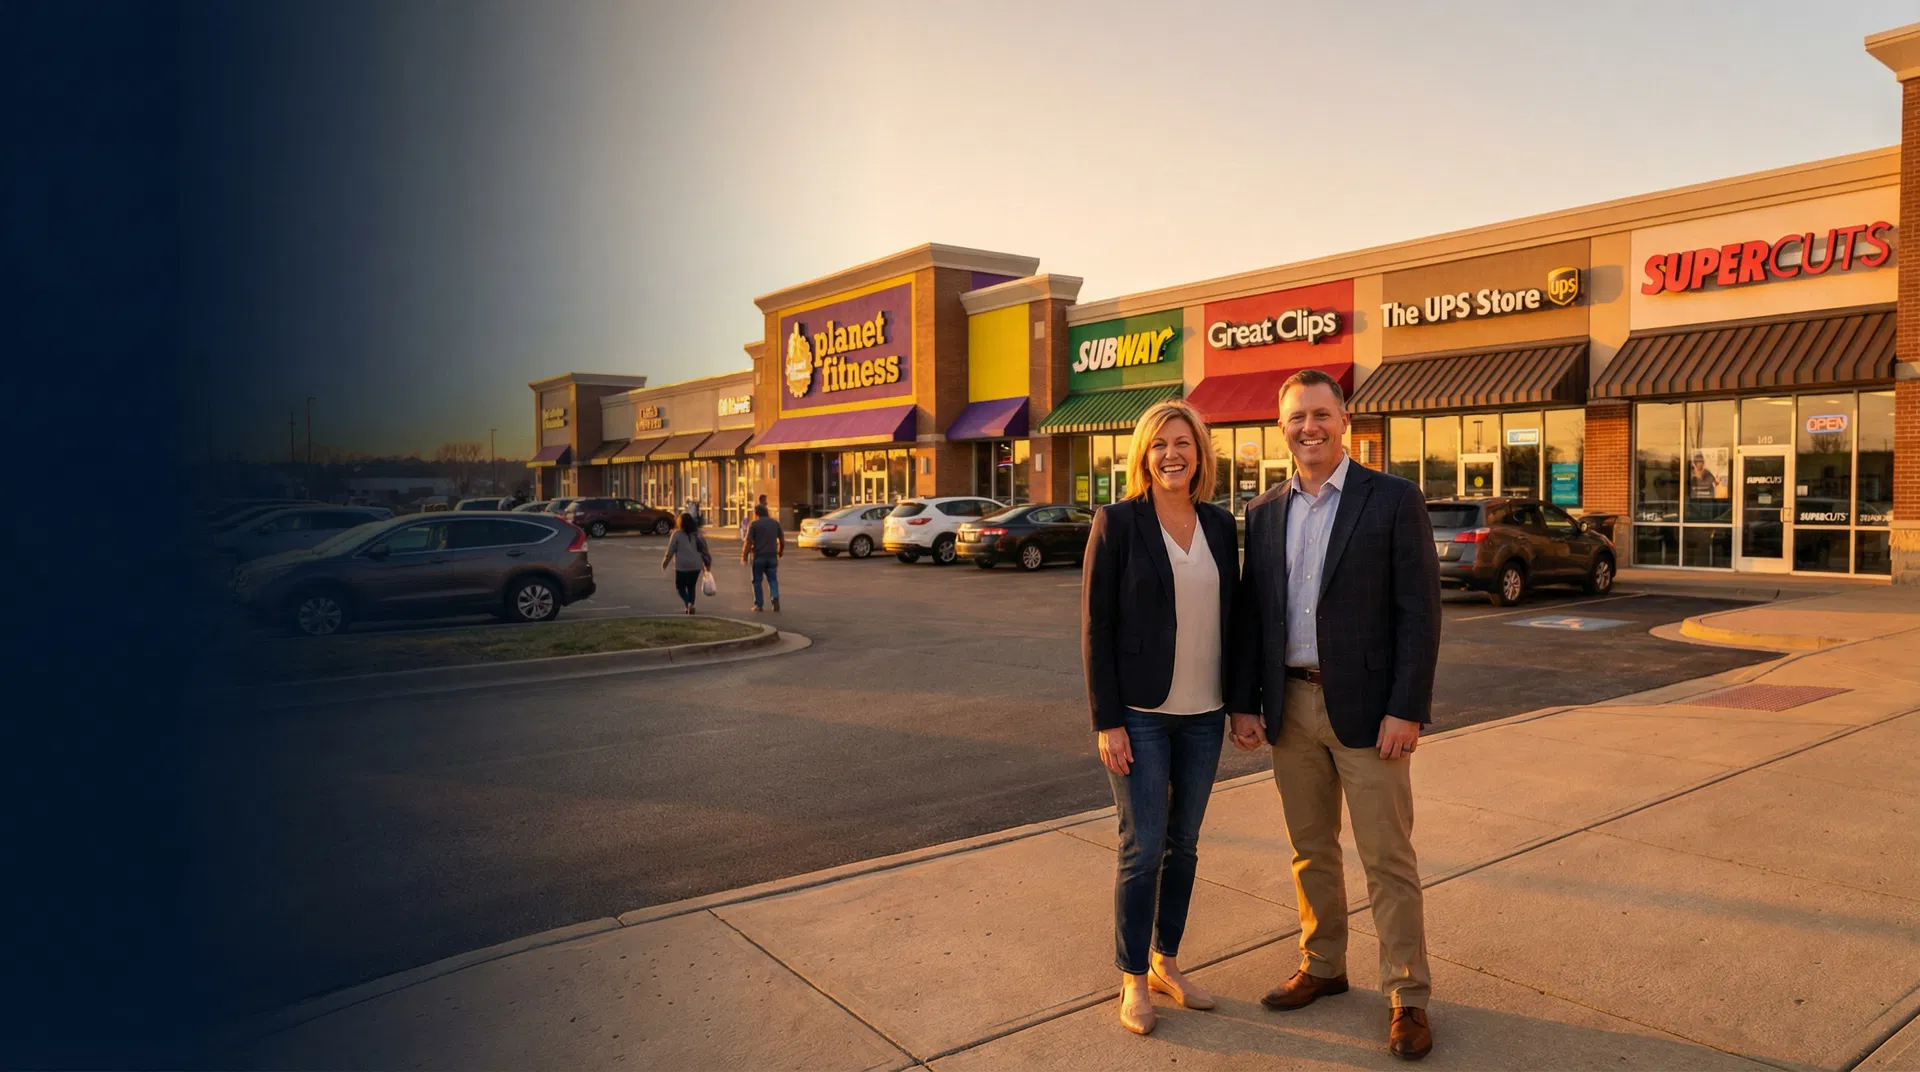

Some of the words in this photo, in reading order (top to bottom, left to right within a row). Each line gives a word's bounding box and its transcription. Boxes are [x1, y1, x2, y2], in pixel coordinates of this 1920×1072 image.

[1641, 221, 1893, 296] SUPERCUTS
[1380, 302, 1419, 328] The
[1425, 292, 1471, 322] UPS
[1476, 288, 1541, 316] Store
[1550, 277, 1576, 300] ups
[813, 310, 885, 368] planet
[1207, 318, 1273, 349] Great
[1276, 309, 1337, 342] Clips
[1072, 326, 1175, 374] SUBWAY
[821, 355, 900, 393] fitness
[1807, 417, 1847, 431] OPEN
[1800, 512, 1846, 521] SUPERCUTS
